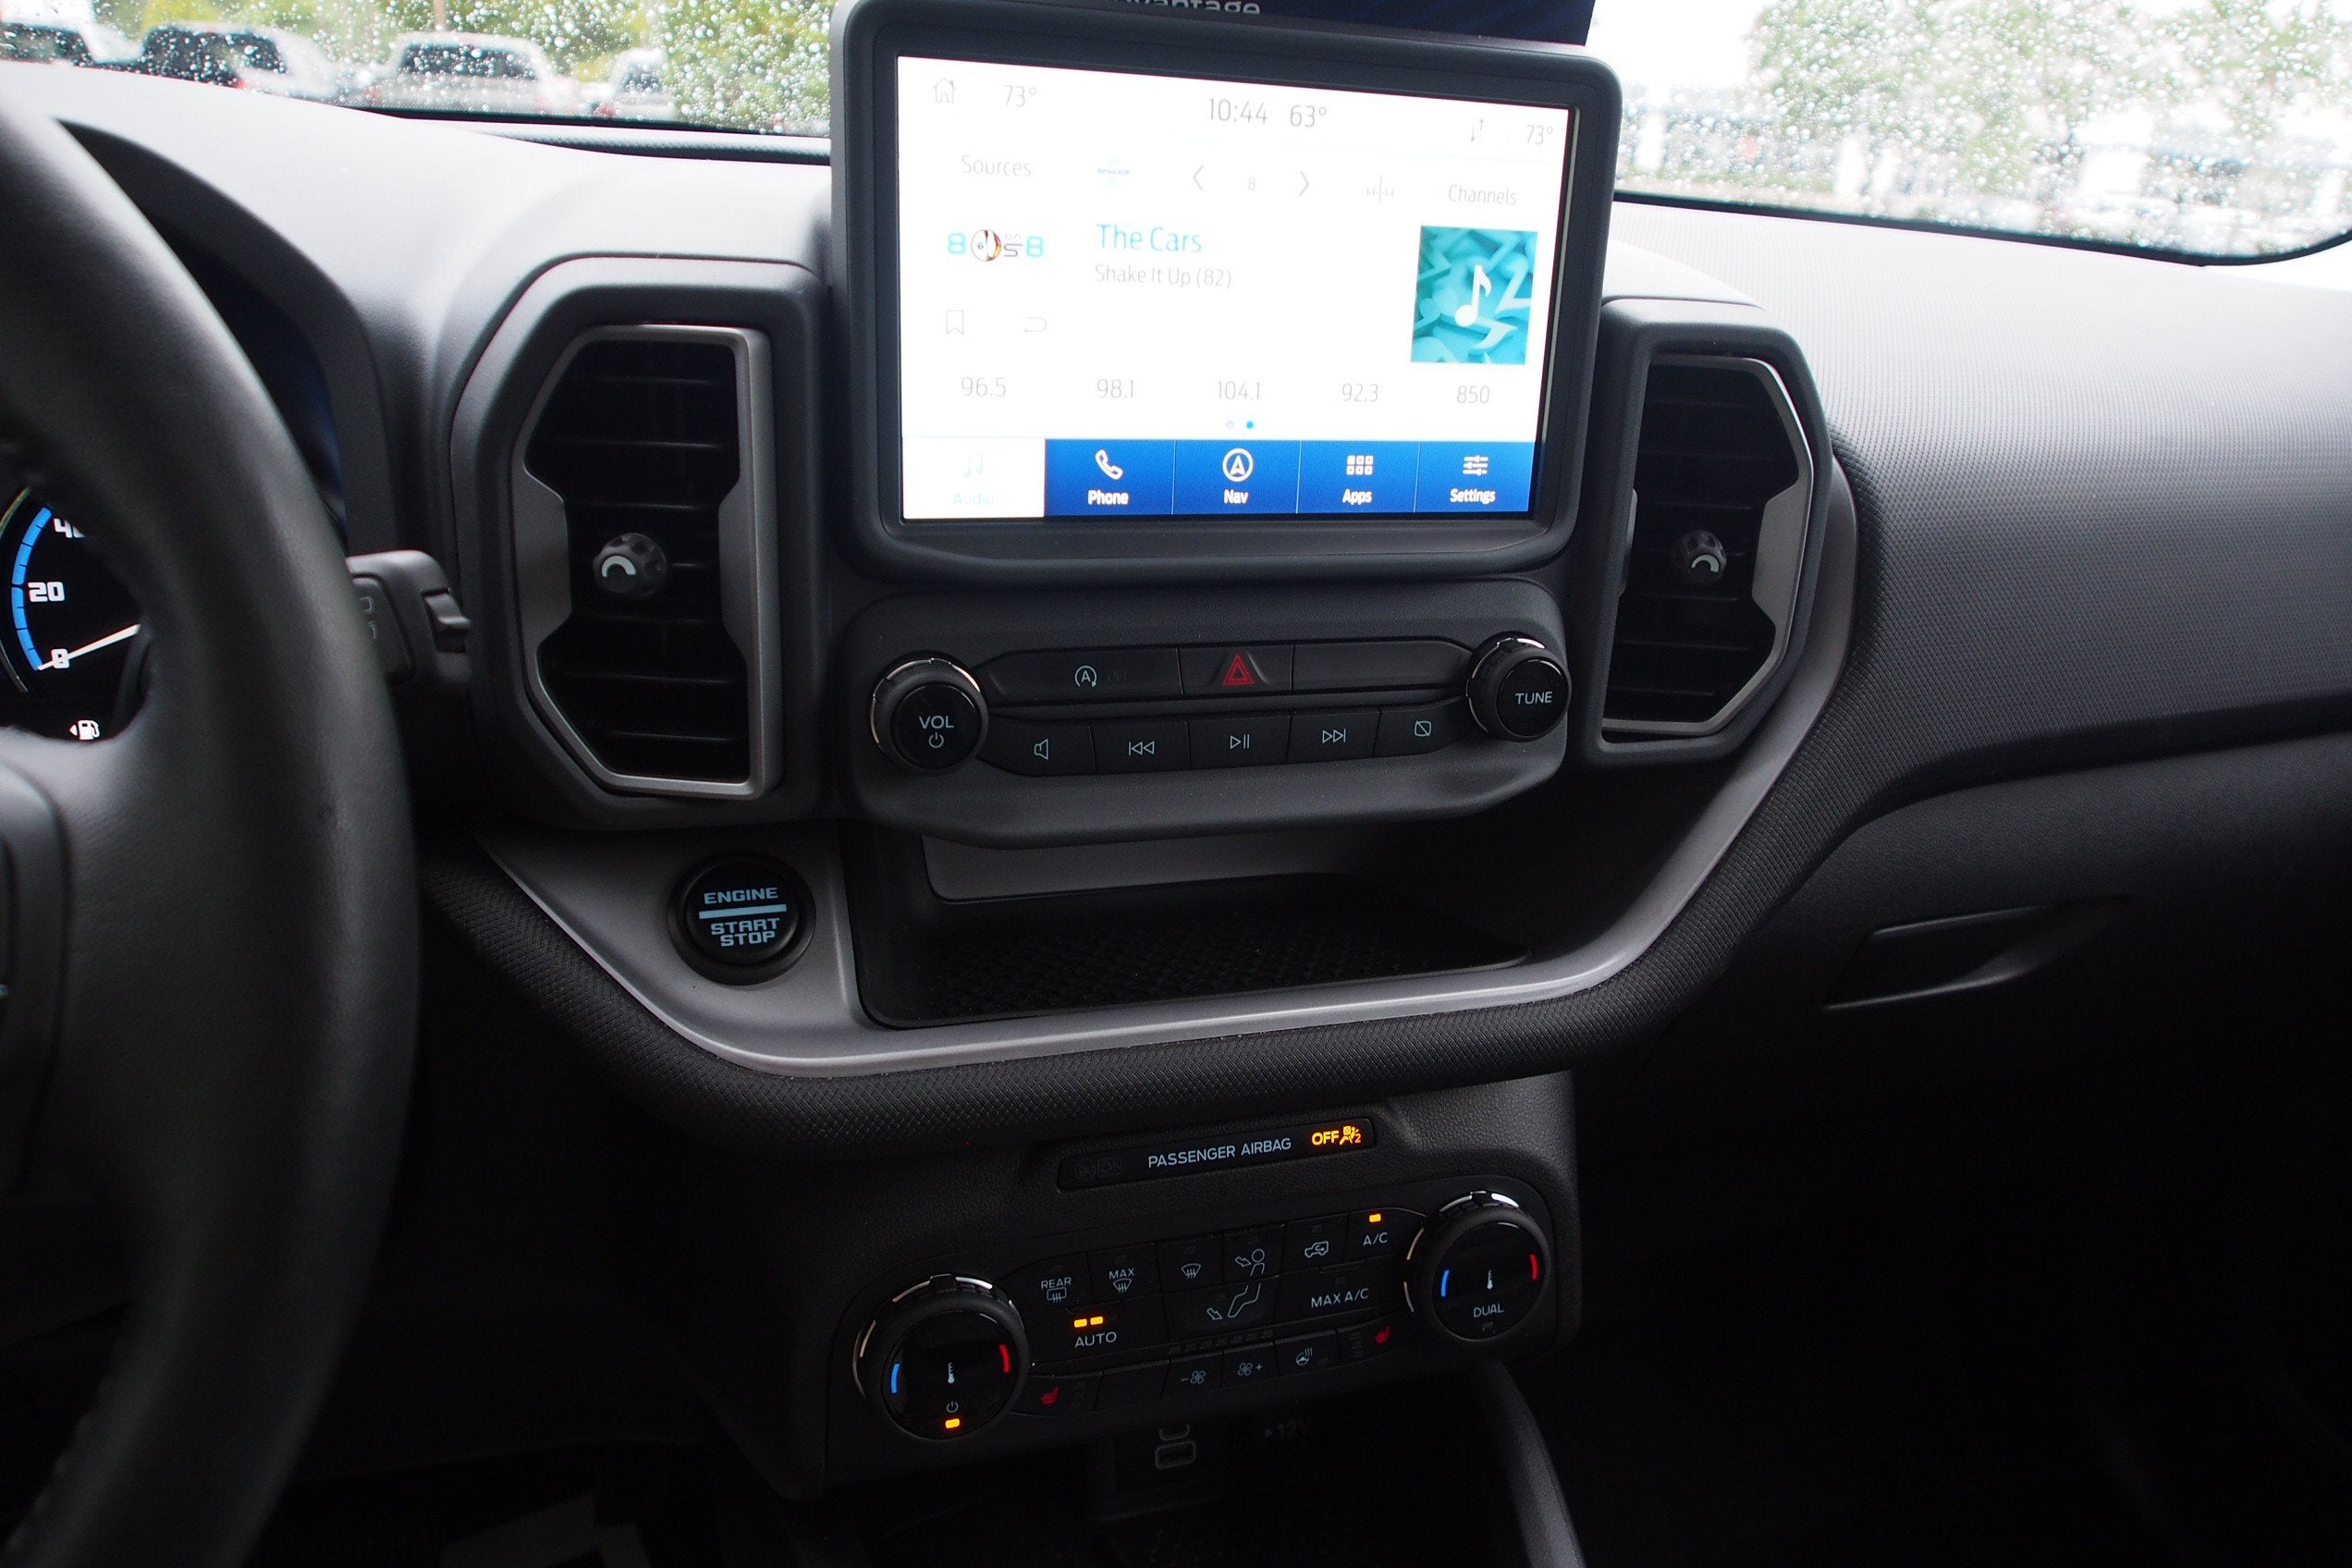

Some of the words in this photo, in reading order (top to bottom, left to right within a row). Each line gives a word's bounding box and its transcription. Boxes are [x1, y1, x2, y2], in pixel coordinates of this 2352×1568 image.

[1209, 98, 1268, 124] 10:44
[1290, 104, 1328, 128] 63°
[961, 154, 1032, 177] Sources
[1247, 176, 1257, 190] 8
[1448, 184, 1517, 206] Channels
[1096, 223, 1143, 250] The
[1149, 227, 1202, 252] Cars
[1095, 263, 1146, 283] Shake
[1152, 267, 1161, 284] It
[1168, 267, 1191, 288] Up
[1196, 268, 1231, 289] (82)
[961, 376, 1006, 398] 96.5
[1096, 378, 1133, 398] 98.1
[1218, 380, 1260, 400] 104.1
[1341, 383, 1378, 402] 92.3
[1456, 385, 1490, 404] 850
[953, 492, 996, 506] Audio
[1087, 489, 1130, 506] Phone
[1223, 488, 1249, 505] Nav
[1341, 488, 1373, 506] Apps
[1449, 487, 1497, 505] Settings
[27, 581, 66, 603] 20
[1514, 691, 1553, 704] TUNE
[918, 715, 955, 729] VOL
[704, 887, 778, 904] ENGINE
[710, 917, 781, 936] START
[719, 930, 777, 948] STOP
[1148, 1145, 1236, 1169] PASSENGER
[1241, 1137, 1292, 1157] AIRBAG
[1311, 1129, 1341, 1146] OFF
[1363, 1231, 1388, 1246] A/C
[1038, 1275, 1074, 1291] REAR
[1108, 1267, 1136, 1280] MAX
[1311, 1292, 1341, 1308] MAX
[1344, 1288, 1369, 1303] A/C
[1473, 1303, 1504, 1318] DUAL
[1073, 1330, 1118, 1349] AUTO
